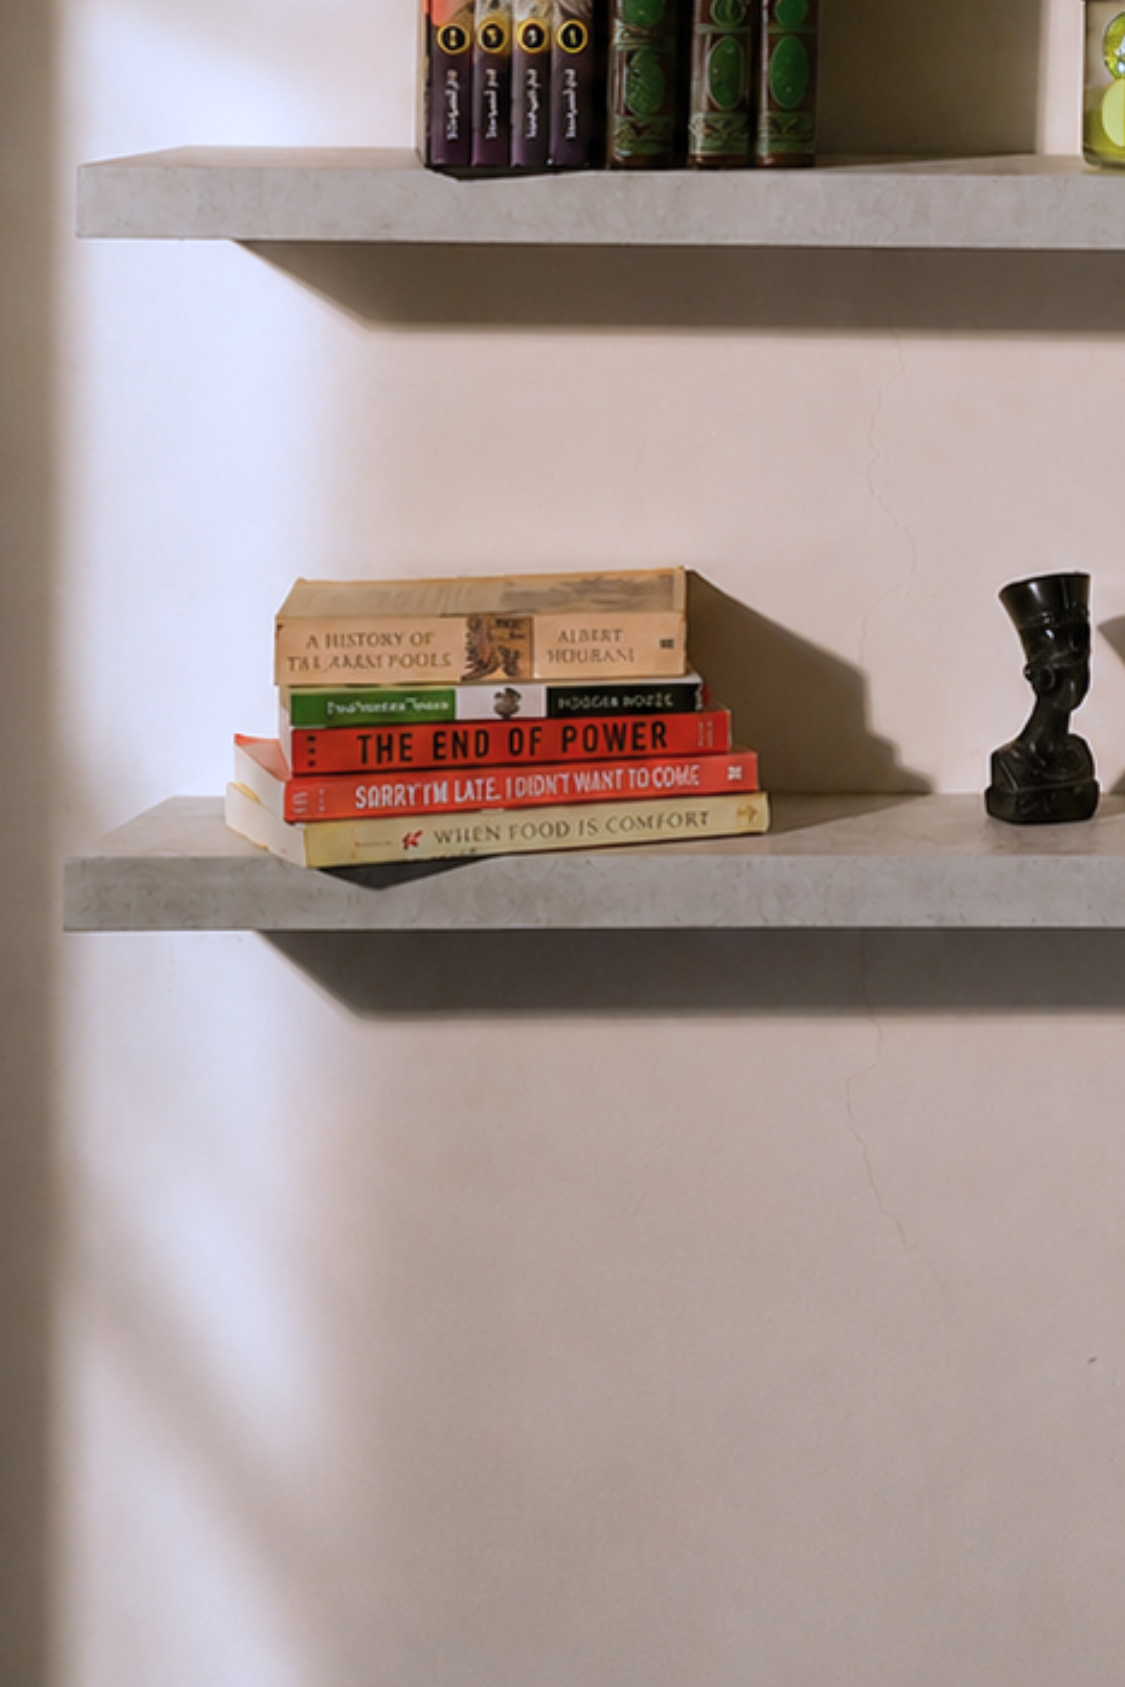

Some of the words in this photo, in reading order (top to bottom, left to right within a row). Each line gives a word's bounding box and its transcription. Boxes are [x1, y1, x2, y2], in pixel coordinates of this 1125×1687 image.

[306, 634, 319, 649] A
[325, 631, 404, 649] HISTORY
[409, 630, 434, 648] OF
[558, 628, 623, 644] ALBERT
[356, 732, 413, 764] THE
[432, 729, 490, 760] END
[508, 726, 543, 756] OF
[561, 720, 668, 753] POWER
[355, 783, 416, 810] SORRY
[505, 776, 513, 800] I
[573, 768, 624, 793] WANT
[628, 767, 650, 790] TO
[652, 764, 700, 788] COME
[433, 824, 501, 845] WHEN
[509, 818, 571, 842] FOOD
[578, 816, 599, 837] IS
[605, 809, 710, 834] COMFORT
